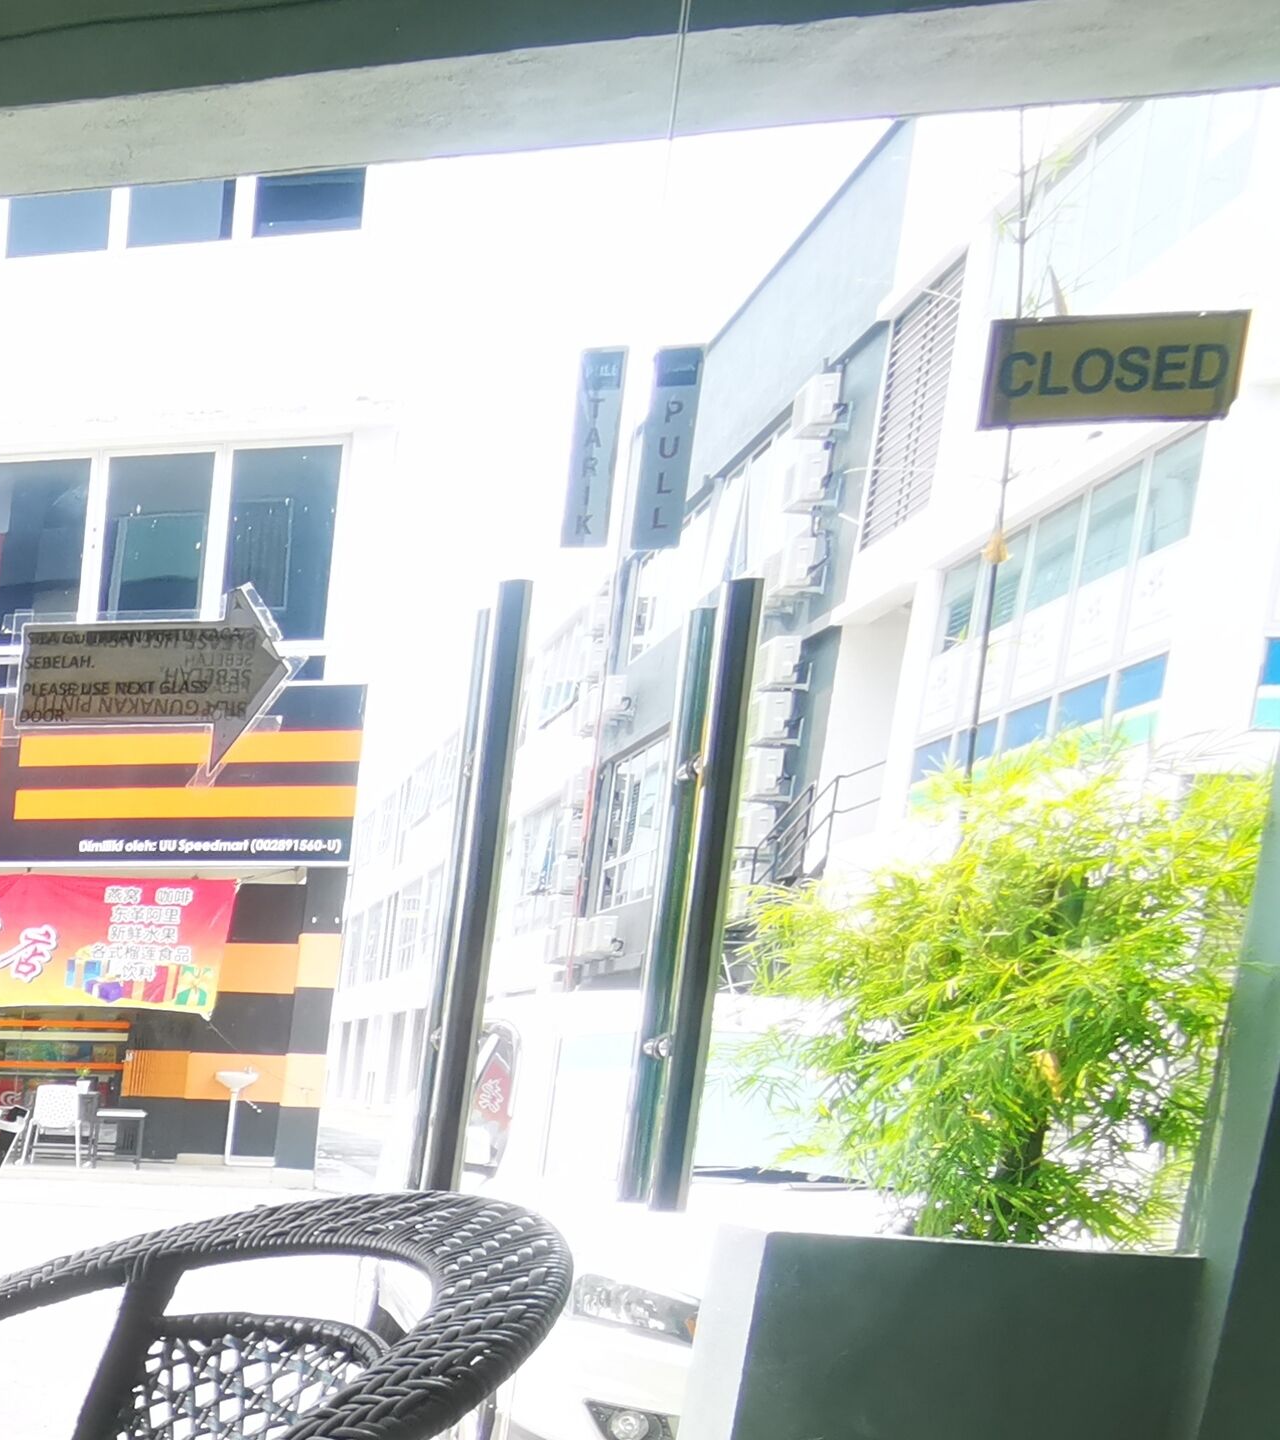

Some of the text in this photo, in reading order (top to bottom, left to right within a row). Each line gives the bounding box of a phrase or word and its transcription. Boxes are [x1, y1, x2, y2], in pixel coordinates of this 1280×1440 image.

[997, 344, 1230, 397] CLOSED
[575, 398, 605, 535] TARIK
[651, 398, 684, 530] PULL
[24, 656, 95, 669] SEBELAH.
[23, 680, 209, 697] PLEASE USE NEXT GLASS
[19, 708, 69, 723] DOOR.
[159, 840, 177, 852] UU
[178, 839, 249, 854] Speedmart
[155, 888, 194, 906] 咖啡
[108, 925, 178, 943] 新鲜水果
[121, 963, 155, 981] 饮料
